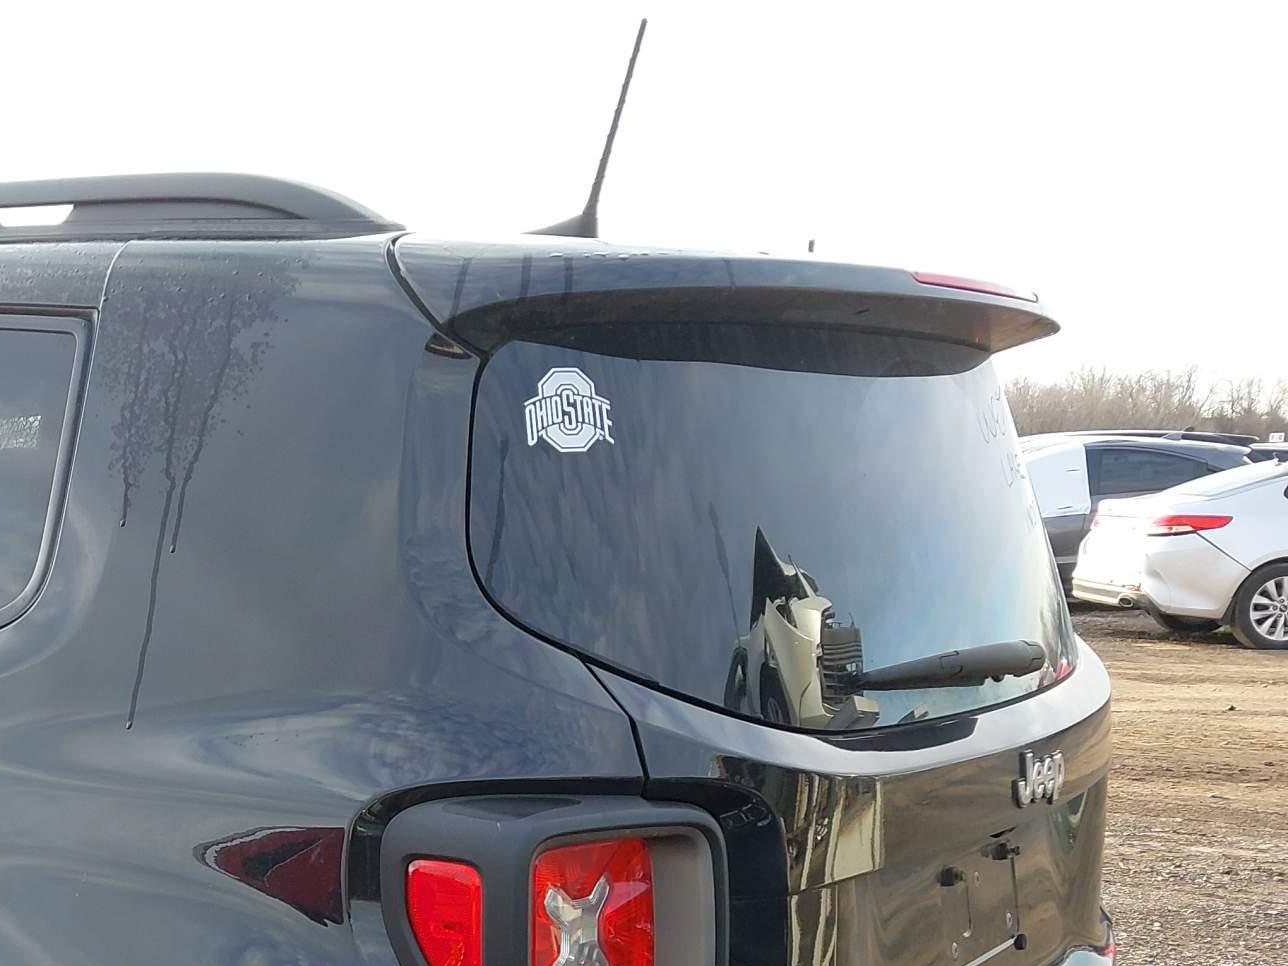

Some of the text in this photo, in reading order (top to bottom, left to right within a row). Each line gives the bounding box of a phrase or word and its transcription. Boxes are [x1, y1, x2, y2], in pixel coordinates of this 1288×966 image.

[525, 389, 614, 446] OHIO STATE
[1013, 749, 1065, 807] Jeep
